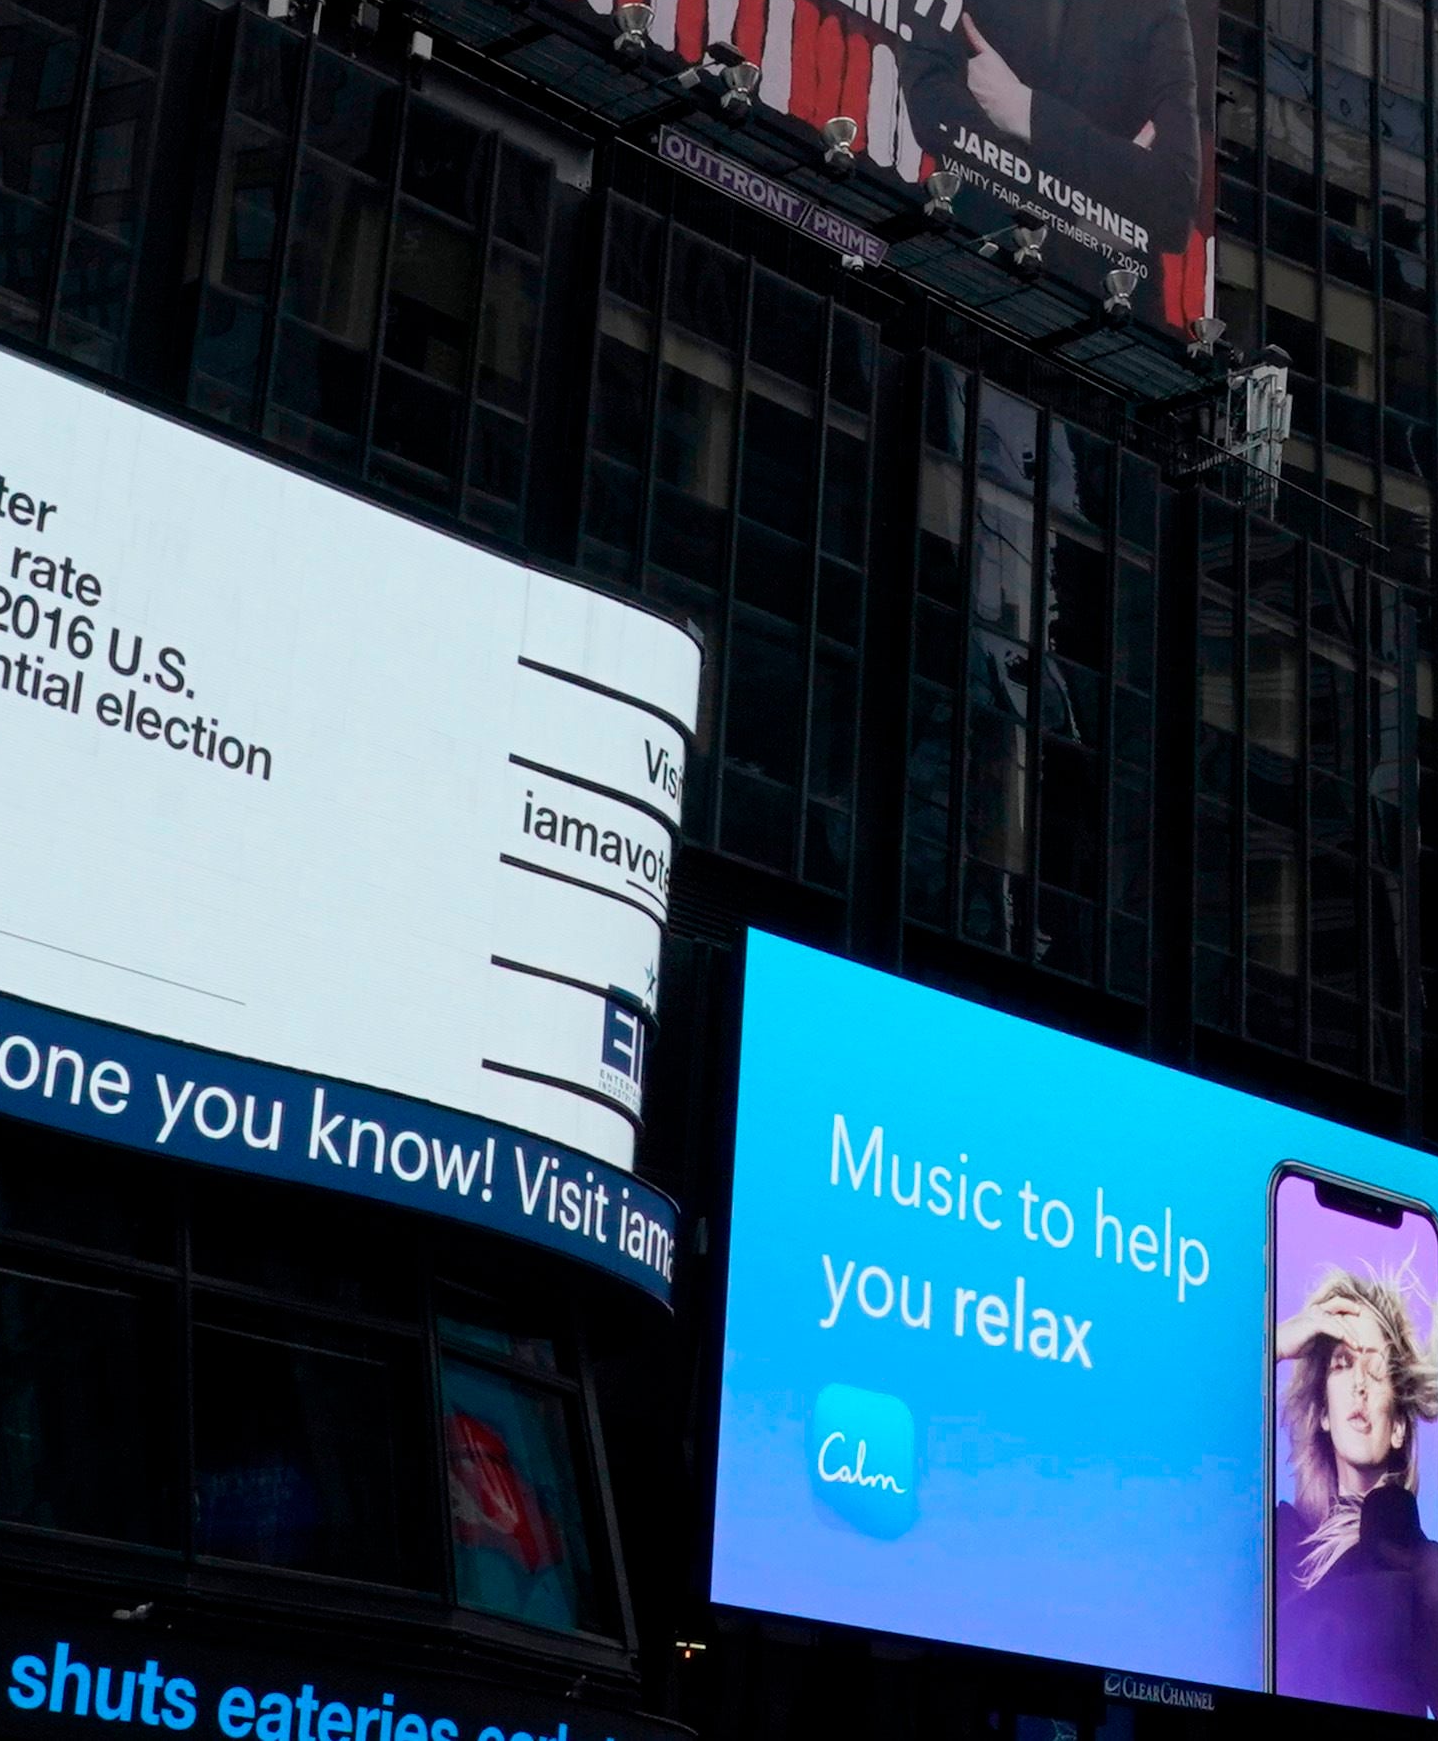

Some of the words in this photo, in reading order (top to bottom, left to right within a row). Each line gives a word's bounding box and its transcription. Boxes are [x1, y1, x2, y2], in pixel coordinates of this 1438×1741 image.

[664, 133, 801, 219] OUTFRONT
[814, 210, 881, 263] PRIME
[941, 153, 990, 191] VANITY
[1116, 250, 1149, 280] 2020
[953, 125, 1033, 185] JARED
[1037, 169, 1150, 254] KUSHNER
[9, 542, 103, 608] rate
[105, 626, 198, 699] U.S.
[94, 686, 274, 782] election
[154, 1070, 284, 1154] you
[308, 1086, 498, 1206] know!
[514, 1143, 608, 1246] Visit
[827, 1112, 1003, 1232] Music
[1017, 1177, 1076, 1251] to
[1092, 1184, 1212, 1305] help
[816, 1252, 932, 1331] you
[953, 1274, 1096, 1370] relax
[815, 1429, 909, 1497] Calm
[8, 1640, 199, 1732] shuts
